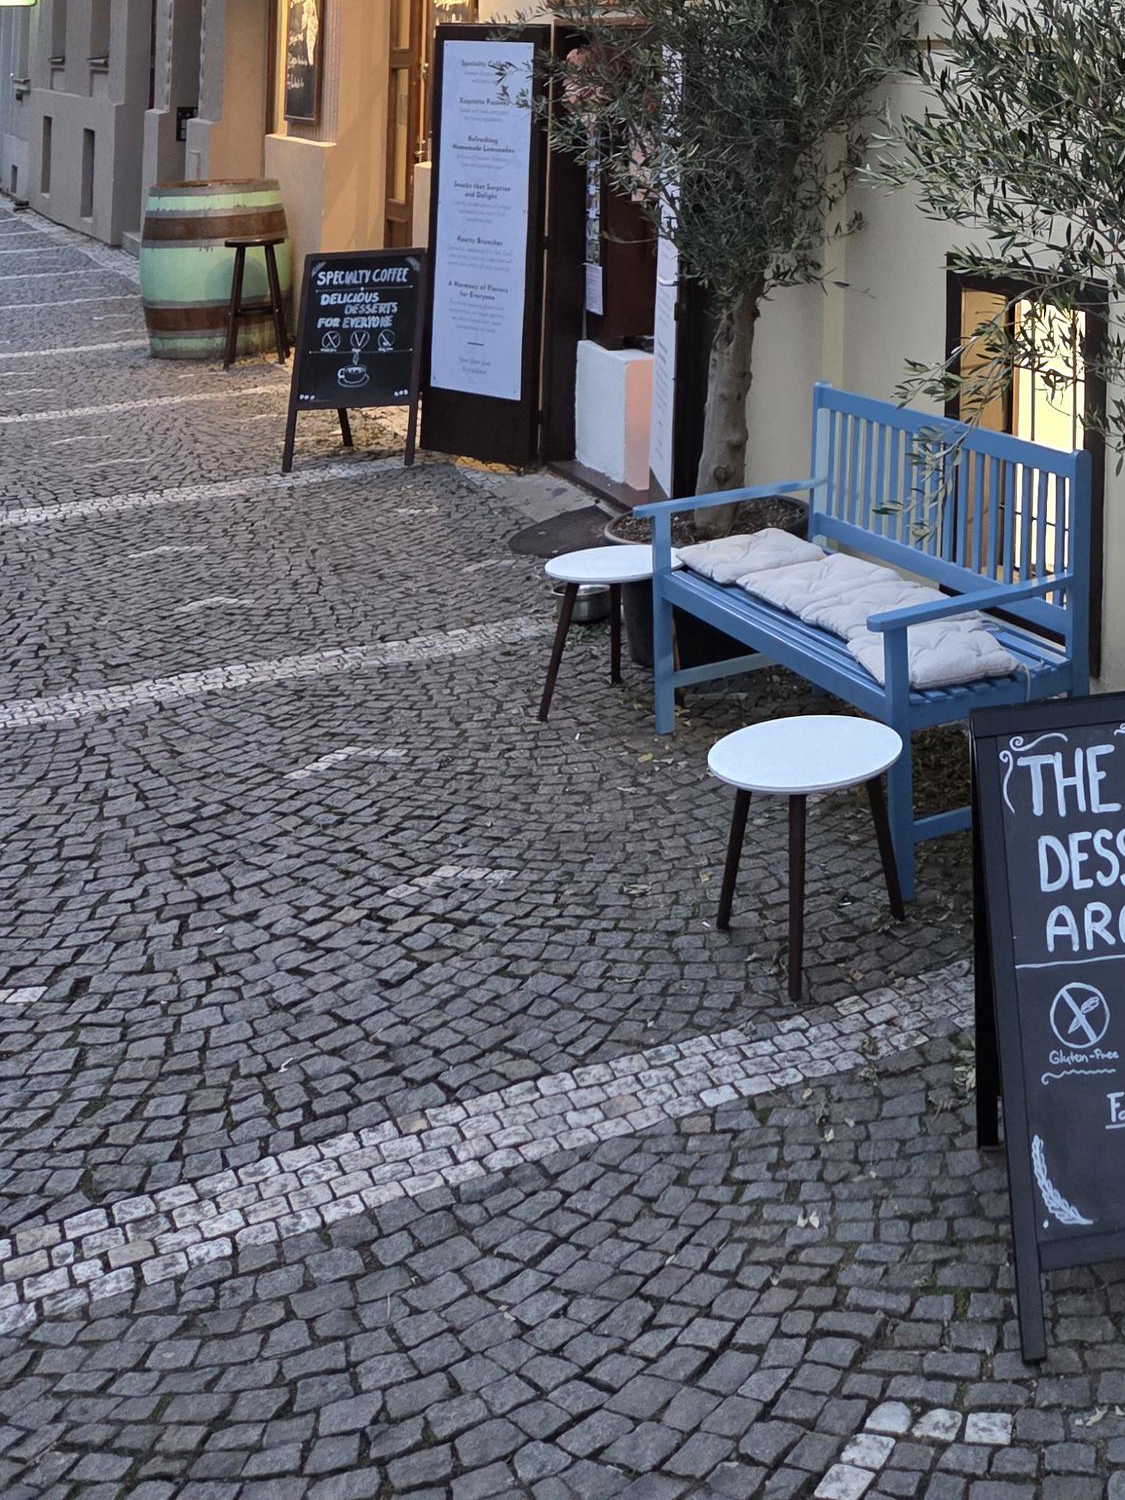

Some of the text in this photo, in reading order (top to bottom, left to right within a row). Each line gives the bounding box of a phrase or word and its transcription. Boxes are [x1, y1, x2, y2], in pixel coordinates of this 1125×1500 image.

[476, 191, 498, 201] Delight
[317, 267, 410, 286] SPECIALTY COFFEE
[320, 292, 380, 306] DELICIOUS
[344, 302, 398, 315] DESSERTS
[317, 315, 393, 329] FOR EVERYONE
[1016, 744, 1122, 817] THE
